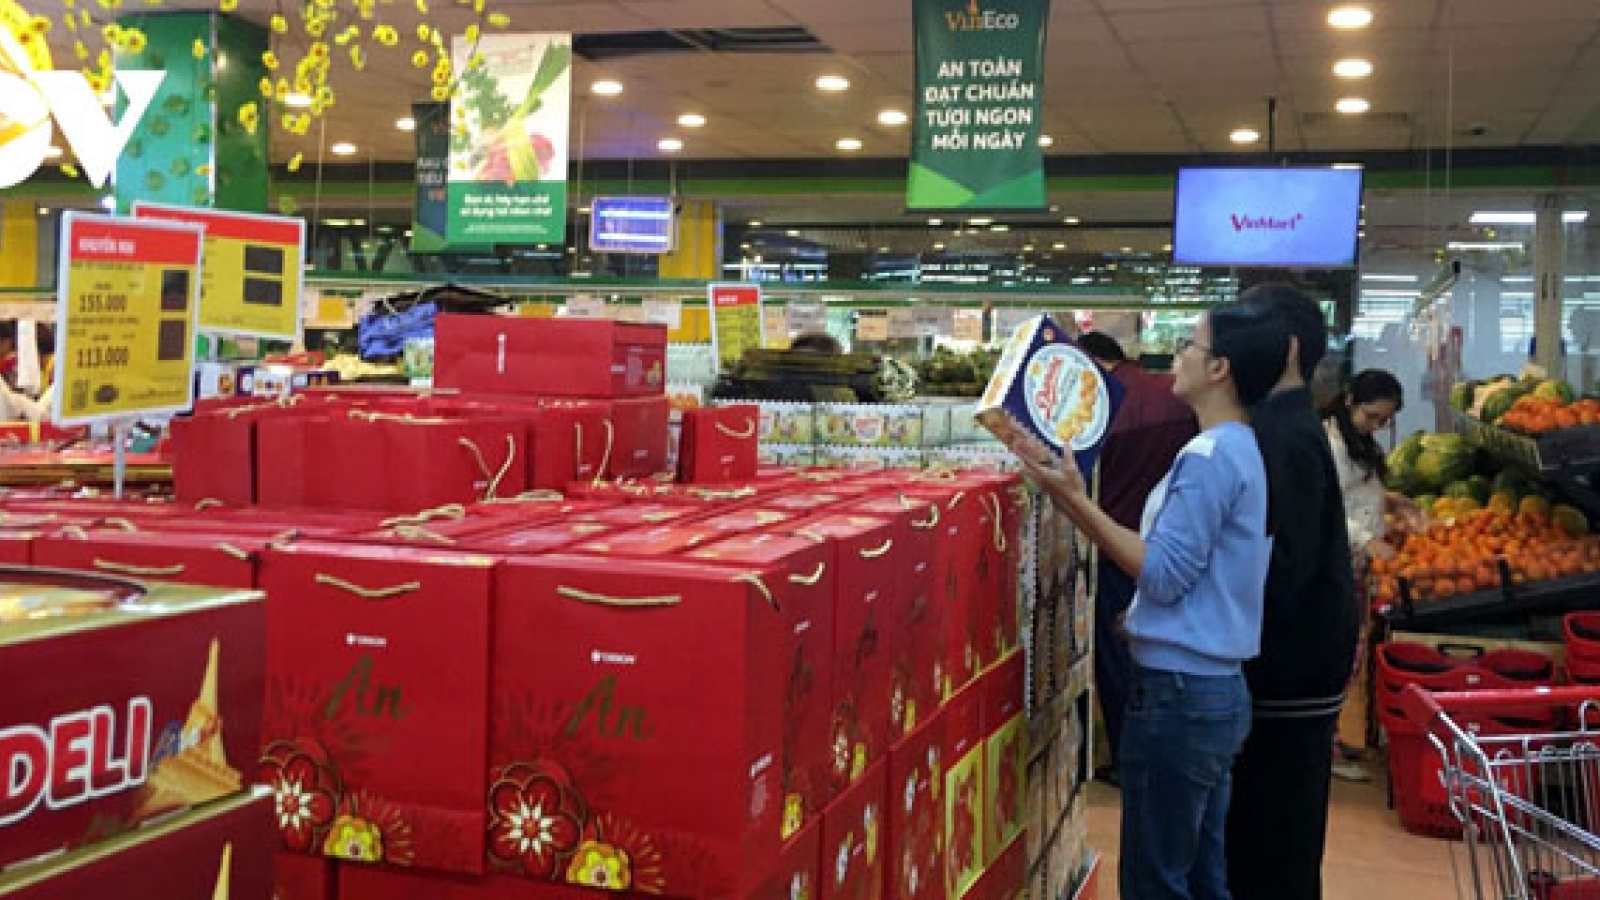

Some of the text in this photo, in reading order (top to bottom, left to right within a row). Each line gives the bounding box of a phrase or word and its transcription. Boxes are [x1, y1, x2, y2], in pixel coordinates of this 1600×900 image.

[937, 61, 964, 79] AN
[975, 107, 1033, 126] NGON
[562, 673, 656, 742] An
[0, 695, 153, 827] DELI
